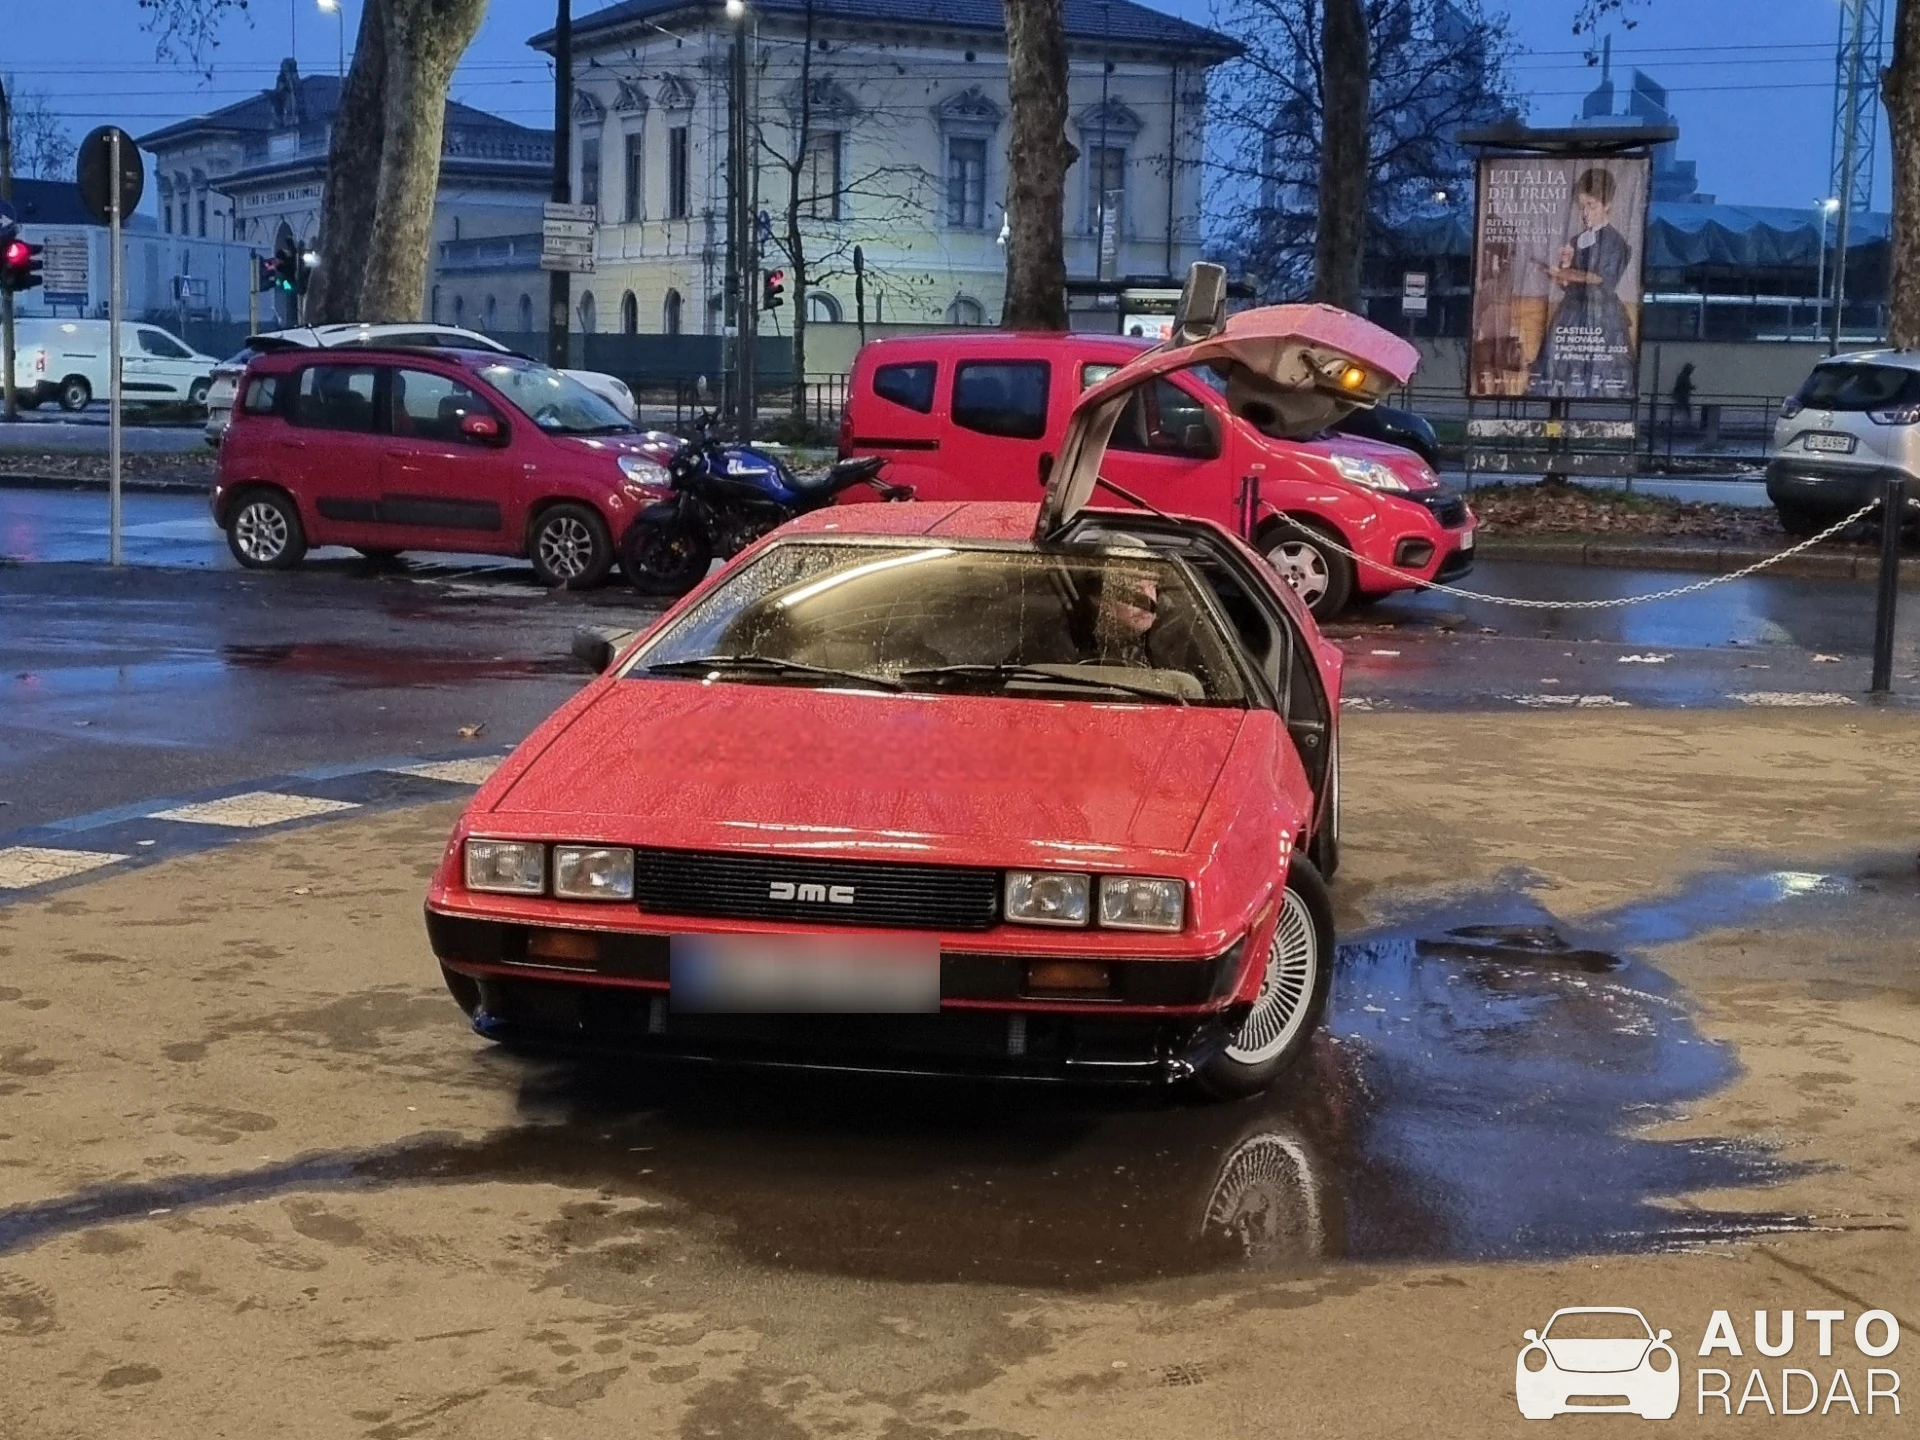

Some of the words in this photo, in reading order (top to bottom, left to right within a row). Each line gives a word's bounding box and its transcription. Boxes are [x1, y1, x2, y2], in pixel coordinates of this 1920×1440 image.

[1489, 169, 1567, 185] L'ITALIA
[1487, 187, 1514, 200] DEI
[1520, 187, 1567, 200] PRIMI
[1487, 202, 1557, 215] ITALIANI
[1556, 327, 1602, 335] CASTELLO
[1567, 336, 1606, 344] NOVARA
[1560, 345, 1606, 353] NOVEMBRE
[1562, 354, 1590, 362] APRILE
[769, 881, 855, 904] DMC
